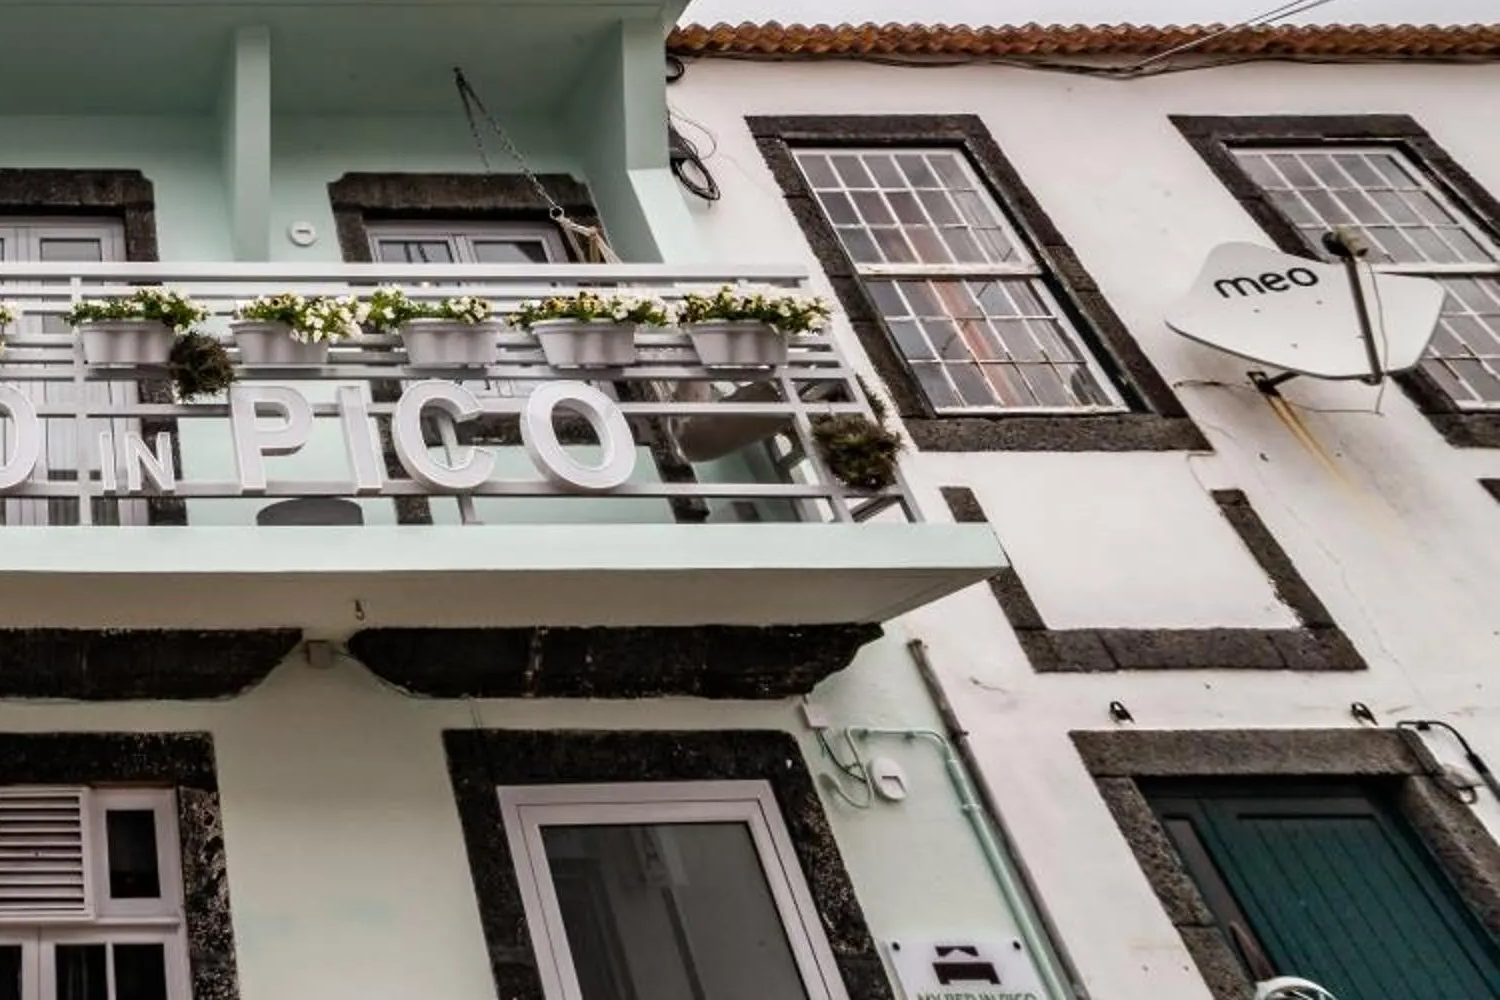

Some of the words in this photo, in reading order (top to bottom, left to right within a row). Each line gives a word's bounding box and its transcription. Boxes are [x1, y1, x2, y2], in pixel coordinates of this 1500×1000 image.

[1213, 266, 1319, 299] meo
[99, 430, 176, 495] IN
[228, 378, 636, 495] PICO
